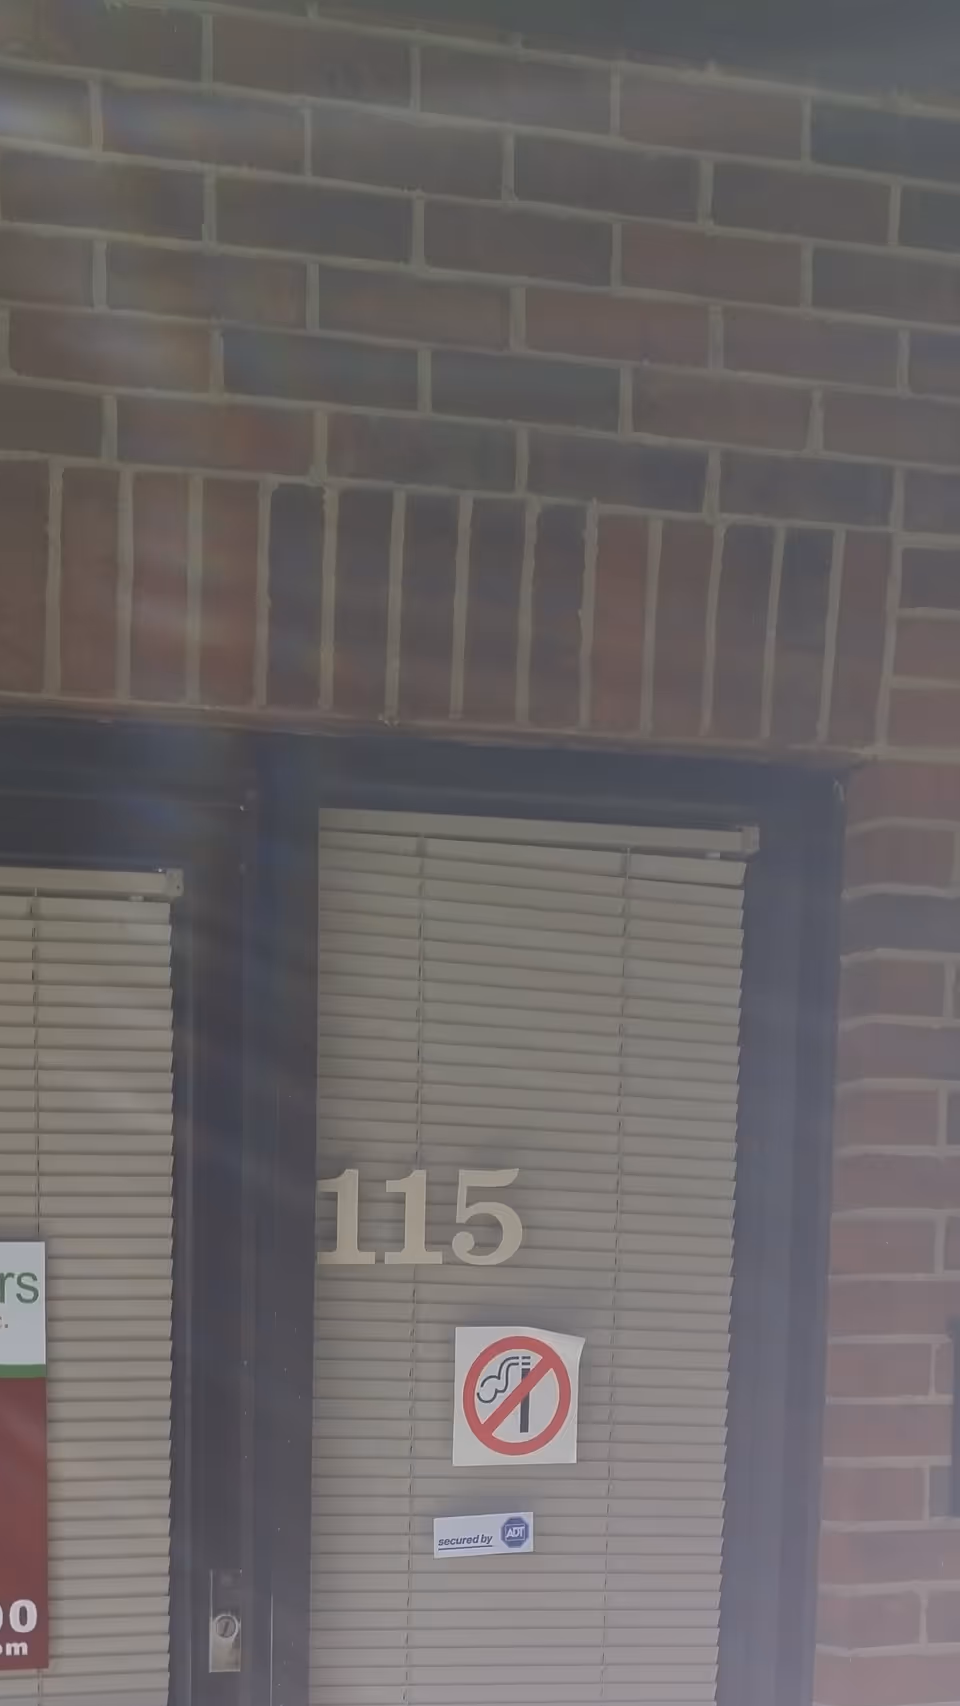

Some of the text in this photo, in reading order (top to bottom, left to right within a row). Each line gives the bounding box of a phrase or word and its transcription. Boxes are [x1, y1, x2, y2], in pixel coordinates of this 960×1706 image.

[316, 1168, 523, 1265] 115
[505, 1526, 525, 1539] ADT
[438, 1533, 493, 1547] secured by
